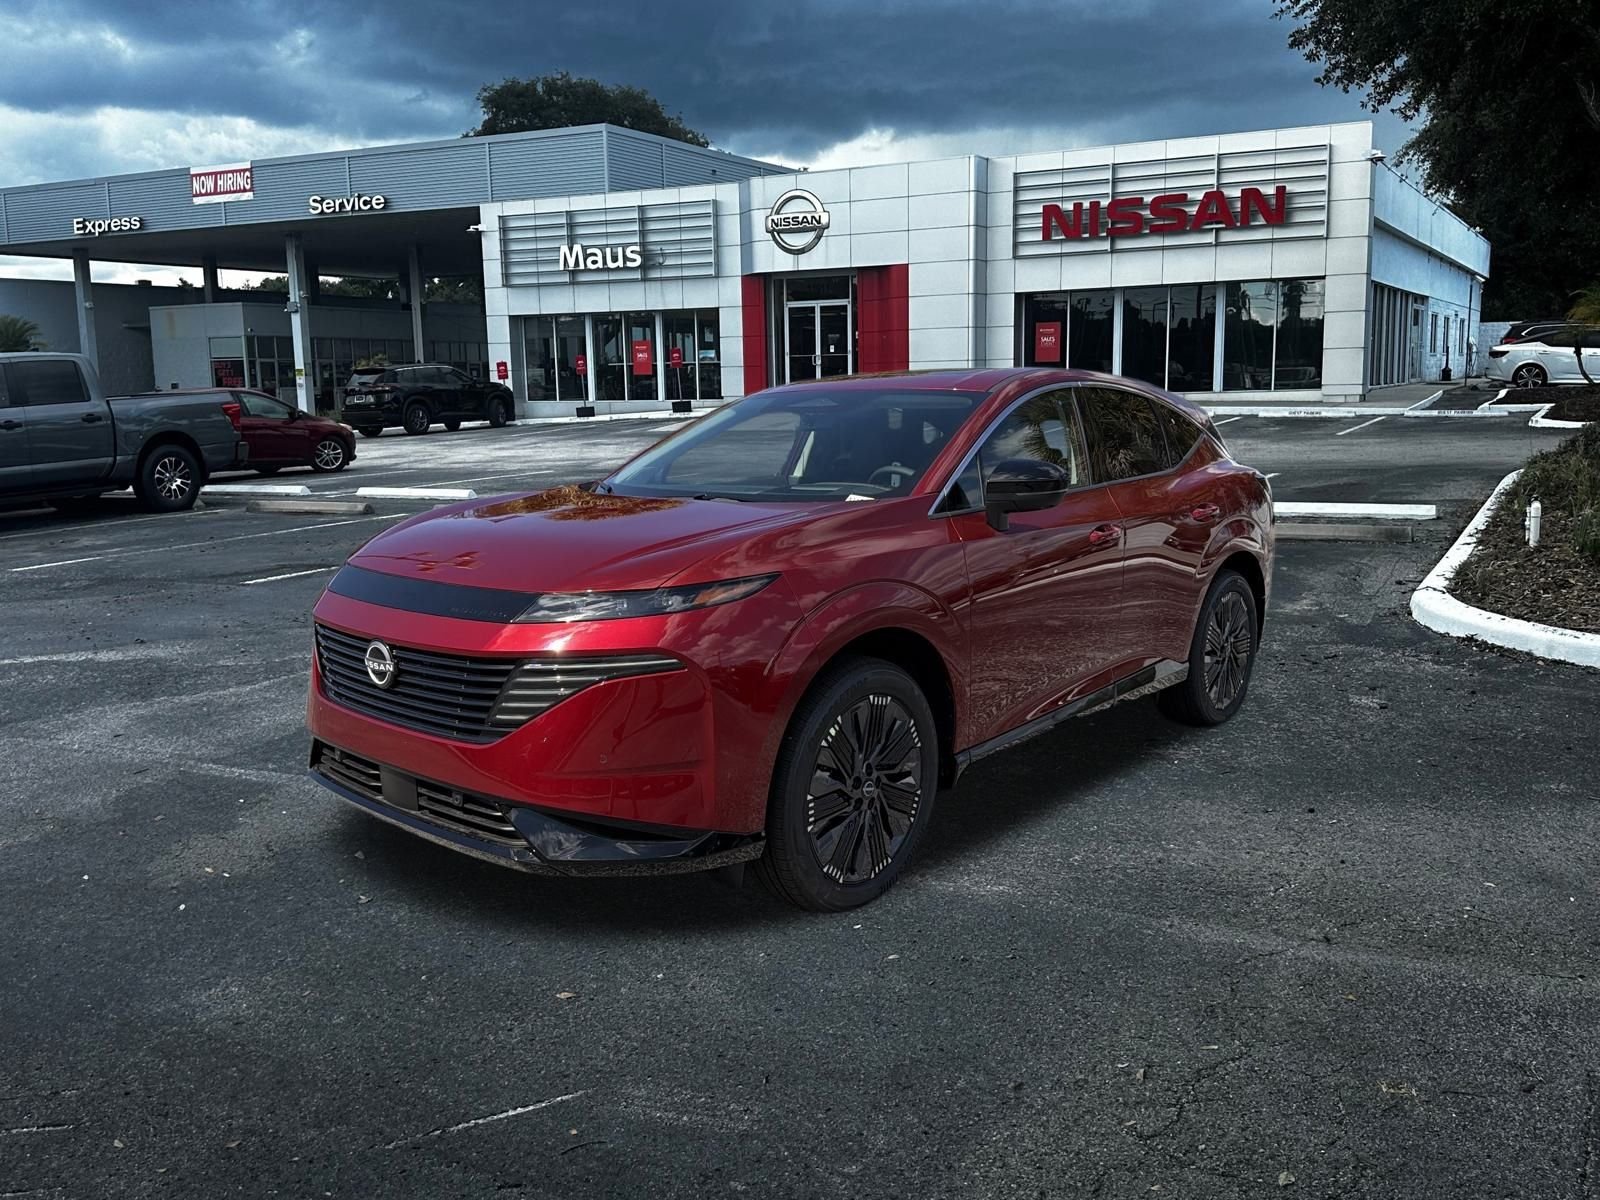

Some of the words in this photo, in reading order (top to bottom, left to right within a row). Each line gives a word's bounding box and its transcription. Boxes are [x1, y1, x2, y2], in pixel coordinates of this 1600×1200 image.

[192, 174, 215, 195] NOW
[217, 170, 251, 193] HIRING
[308, 193, 385, 215] Service
[1041, 185, 1287, 241] NISSAN
[73, 216, 141, 237] Express
[770, 214, 822, 228] NISSAN
[559, 243, 642, 271] Maus
[366, 660, 393, 672] SSAN
